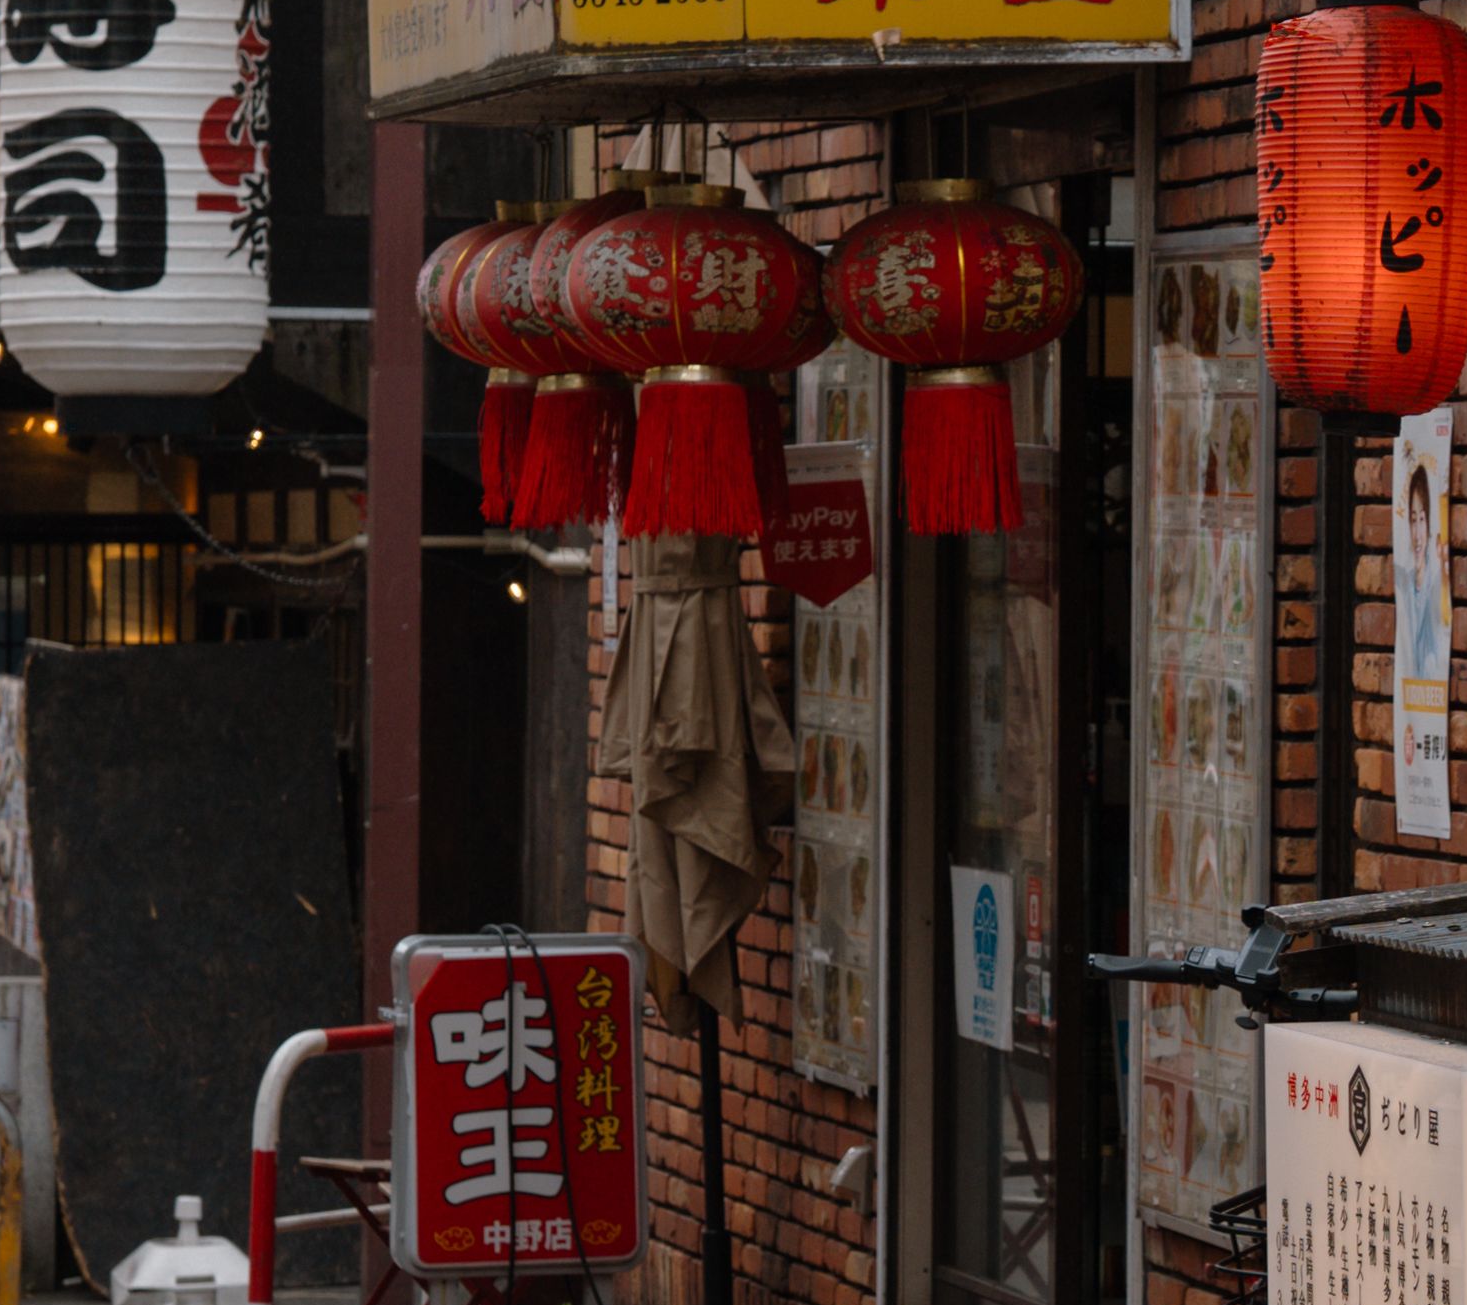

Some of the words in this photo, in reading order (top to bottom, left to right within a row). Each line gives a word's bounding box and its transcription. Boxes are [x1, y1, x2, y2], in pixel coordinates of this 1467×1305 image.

[1379, 65, 1445, 356] ホッピー
[773, 536, 863, 563] 使えます
[574, 967, 622, 1153] 台湾料理
[429, 982, 566, 1206] 味王
[1287, 1071, 1339, 1120] 博多中洲
[1381, 1095, 1441, 1147] ぢどり屋
[482, 1218, 574, 1254] 中野店
[1396, 1189, 1406, 1250] 人気
[1410, 1195, 1421, 1294] ホルモン
[1425, 1200, 1436, 1260] 名物
[1440, 1205, 1451, 1266] 名物
